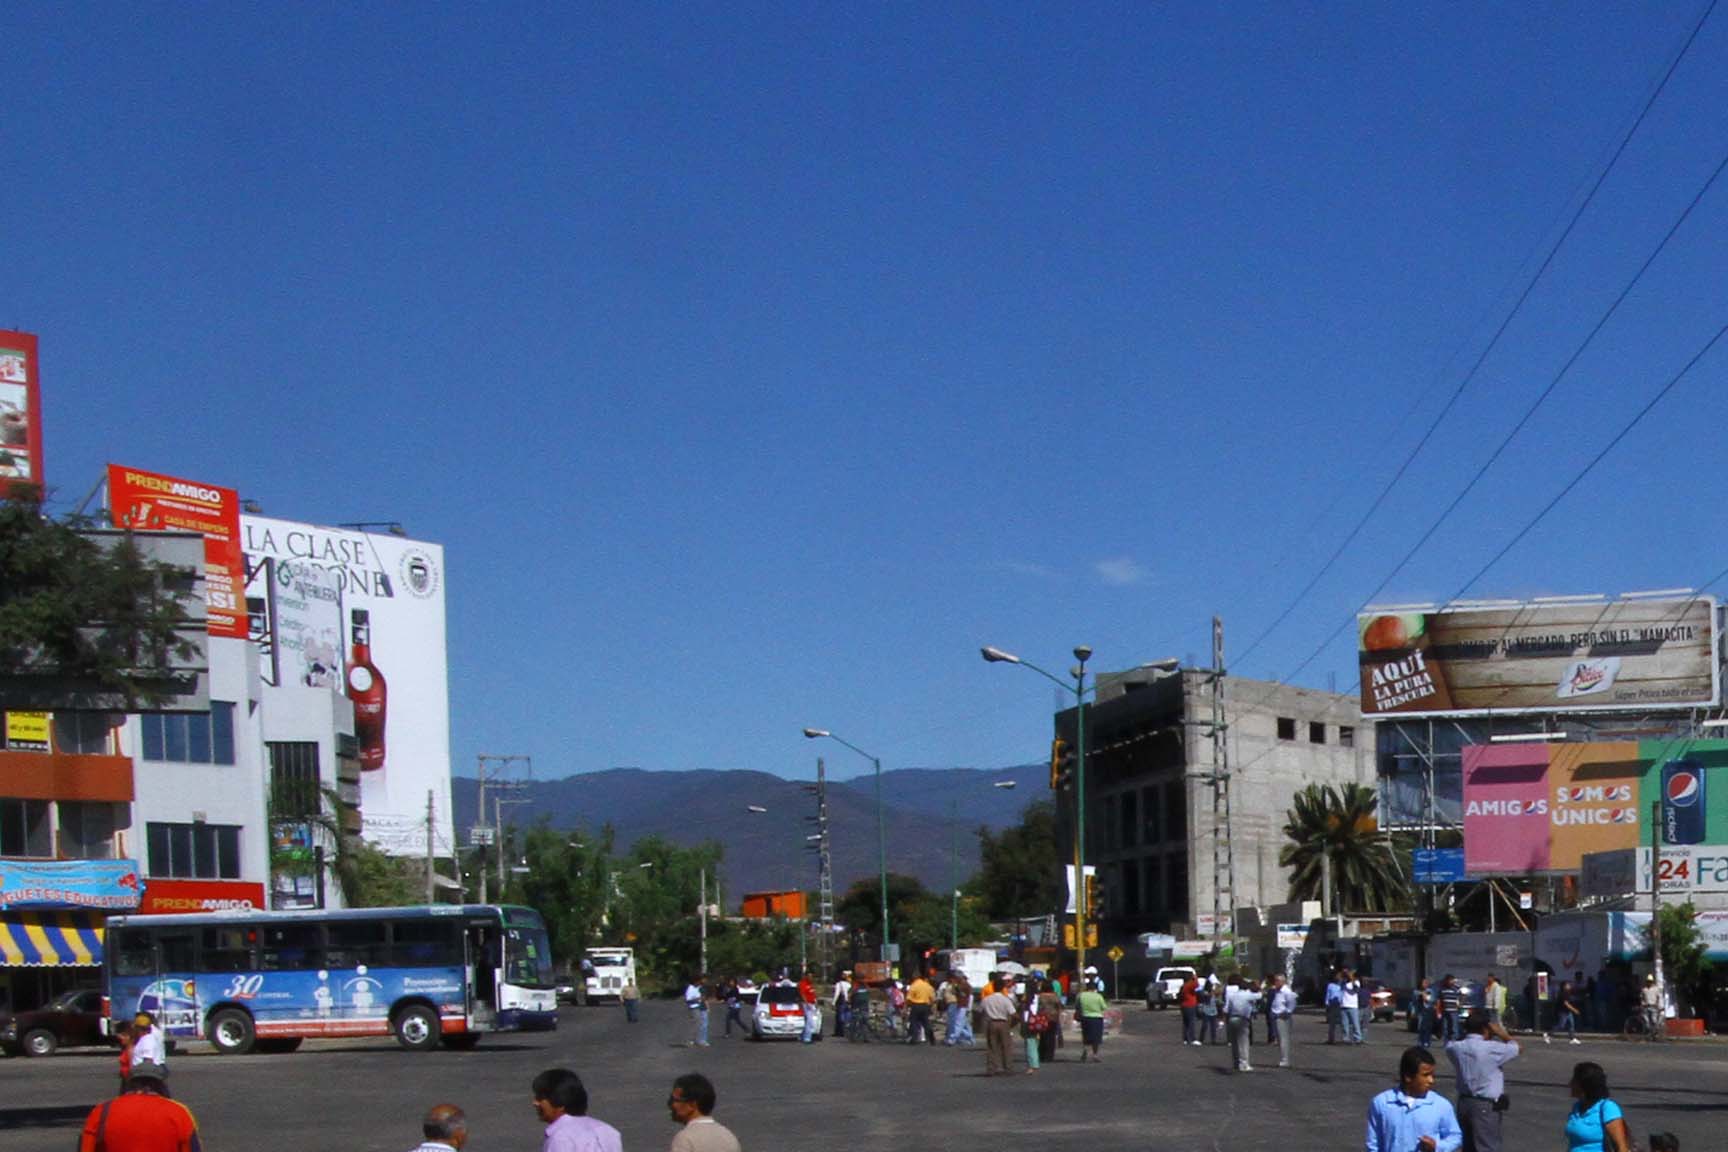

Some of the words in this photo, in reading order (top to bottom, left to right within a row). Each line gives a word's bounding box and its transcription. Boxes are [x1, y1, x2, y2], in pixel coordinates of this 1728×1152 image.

[245, 525, 278, 553] LA
[286, 531, 366, 565] CLASE
[1371, 648, 1428, 687] AQUÍ
[1374, 685, 1392, 701] LA
[1397, 671, 1433, 695] PURA
[1557, 784, 1632, 803] SOMOS
[1465, 799, 1548, 816] AMIGOS
[1551, 805, 1637, 826] ÚNICOS
[1665, 806, 1677, 842] pepsi
[1658, 860, 1690, 880] 24
[224, 974, 264, 997] 30
